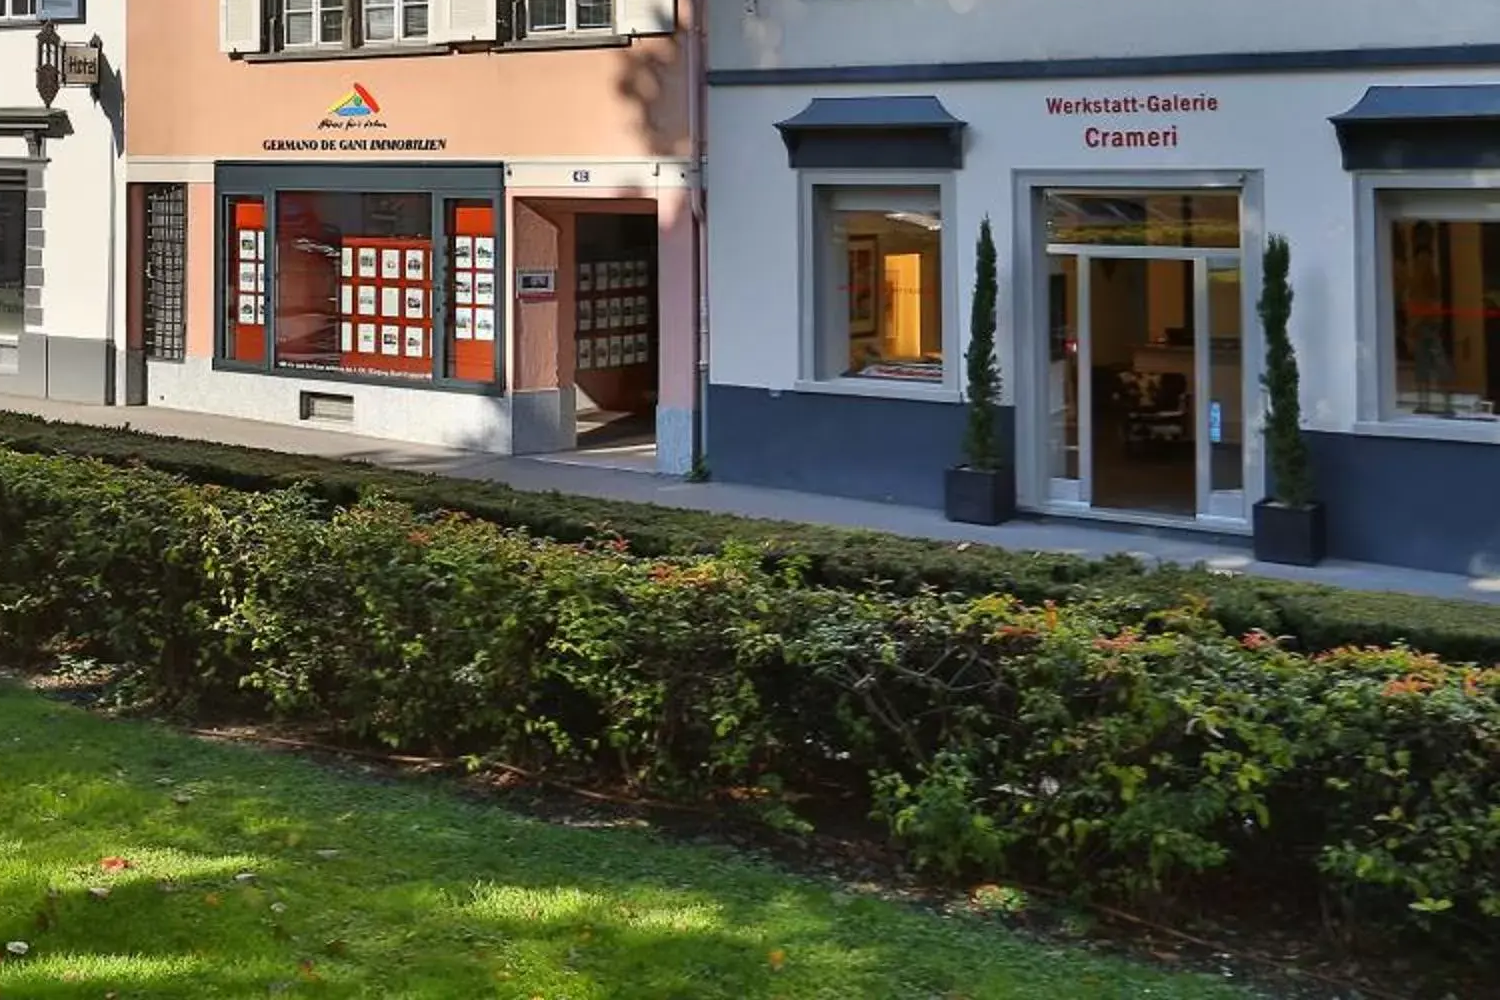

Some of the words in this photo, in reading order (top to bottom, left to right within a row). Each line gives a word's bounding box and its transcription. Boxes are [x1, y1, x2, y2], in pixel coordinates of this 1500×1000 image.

[68, 55, 97, 75] Hotel
[1045, 93, 1219, 115] Werkstatt-Galerie
[263, 138, 319, 151] GERMANO
[320, 138, 336, 151] DE
[339, 138, 368, 151] GANI
[369, 138, 447, 151] IMMOBILIEN
[1085, 124, 1178, 149] Crameri
